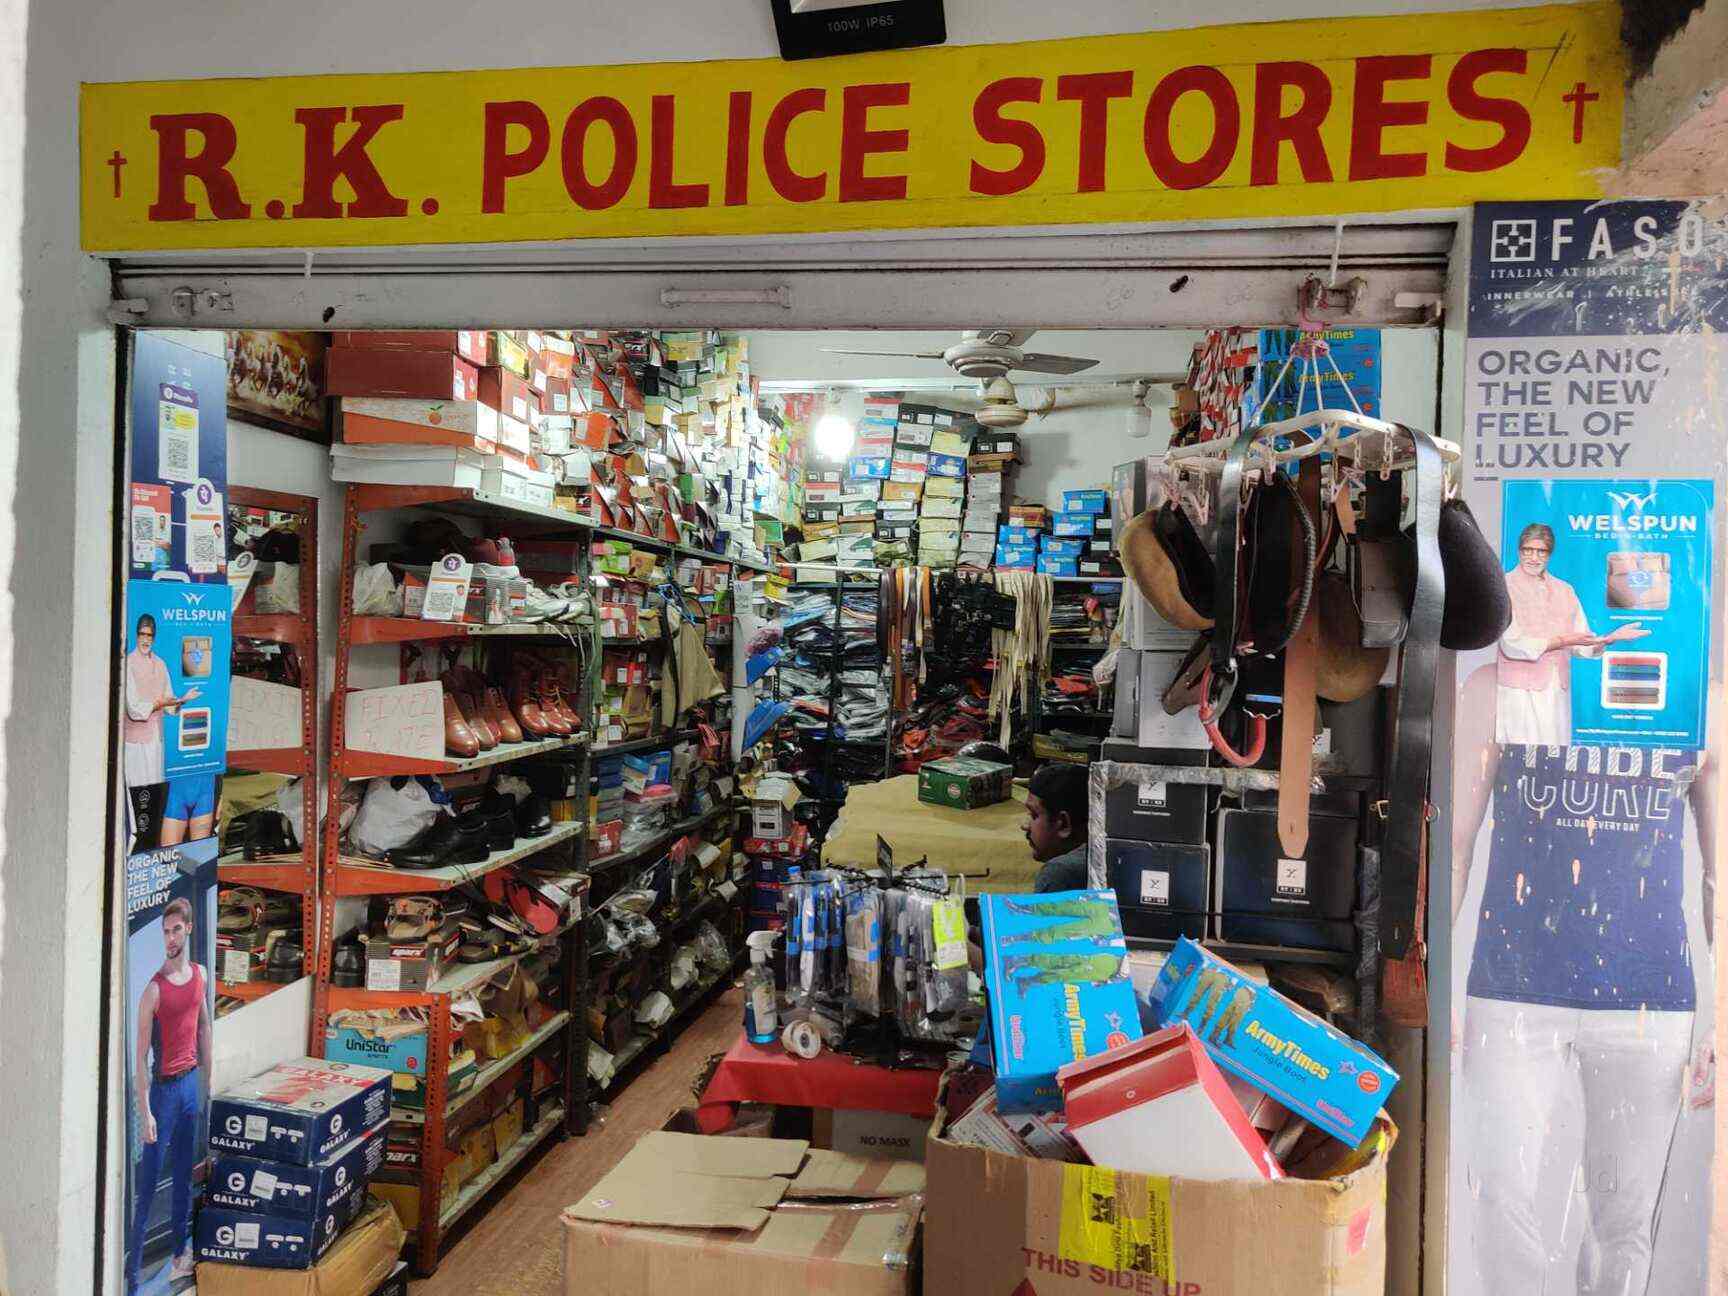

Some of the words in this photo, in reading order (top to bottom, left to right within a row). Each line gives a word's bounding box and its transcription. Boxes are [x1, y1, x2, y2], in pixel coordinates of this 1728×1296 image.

[826, 18, 860, 33] 100W
[867, 15, 894, 32] IP65
[148, 104, 439, 222] R.K.
[481, 82, 911, 214] POLICE
[968, 48, 1533, 197] STORES
[1551, 215, 1704, 261] FASO
[1490, 268, 1554, 279] ITALIAN
[1561, 267, 1580, 277] AT
[1487, 290, 1575, 301] INNERWEAR
[1478, 348, 1670, 377] ORGANIC,
[1477, 381, 1552, 406] THE
[1567, 380, 1656, 405] NEW
[1476, 411, 1569, 437] FEEL
[1583, 411, 1635, 436] OF
[1475, 443, 1632, 468] LUXURY
[1568, 514, 1697, 532] WELSPUN
[162, 608, 227, 622] WELSPUN
[127, 870, 149, 885] THE
[155, 862, 178, 877] NEW
[127, 883, 152, 899] FEEL
[156, 879, 172, 890] OF
[127, 890, 171, 914] LUXURY
[346, 1038, 392, 1054] UniStar
[1245, 1020, 1330, 1080] ArmyTimes
[211, 1136, 252, 1151] GALAXY
[320, 1130, 348, 1153] GALAXY
[860, 1136, 876, 1146] NO
[213, 1194, 256, 1208] GALAXY
[326, 1181, 353, 1207] GALAXY
[201, 1248, 247, 1260] GALAXY
[1022, 1247, 1081, 1278] THIS
[1088, 1264, 1153, 1296] SIDE
[1163, 1280, 1202, 1296] UP
